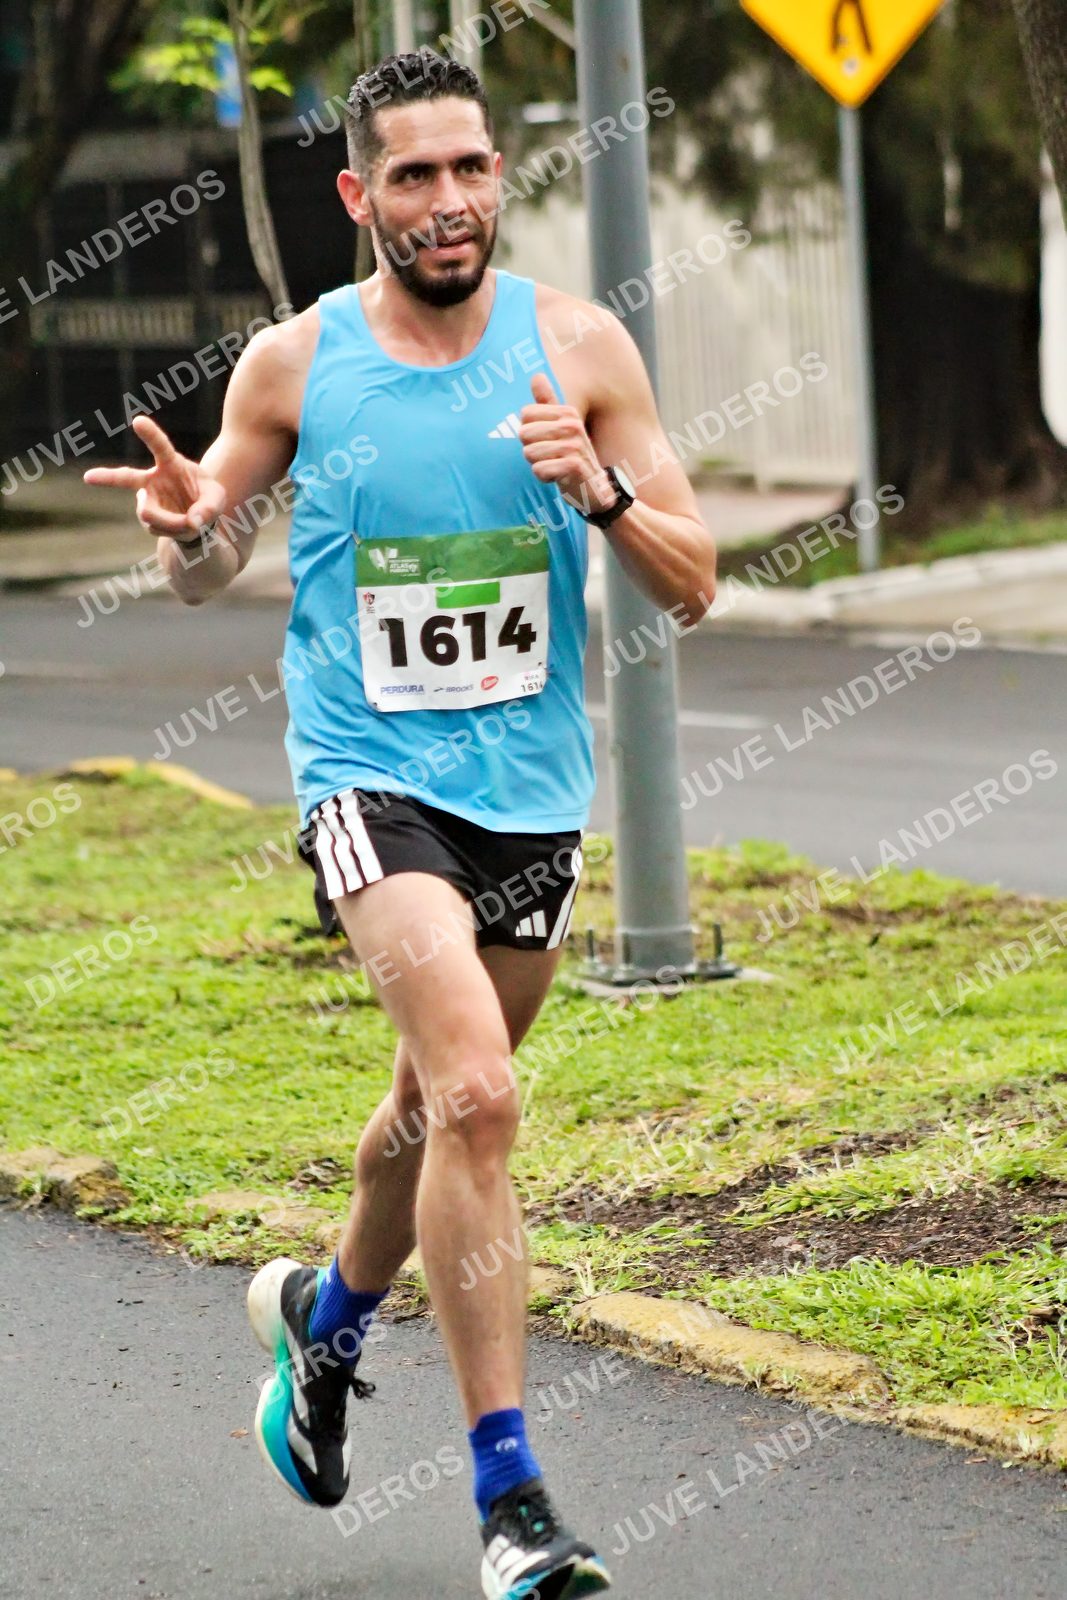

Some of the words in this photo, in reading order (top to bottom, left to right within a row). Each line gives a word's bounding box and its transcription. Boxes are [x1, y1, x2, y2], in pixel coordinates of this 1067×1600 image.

[379, 606, 537, 668] 1614
[380, 684, 424, 695] PERDURA
[446, 684, 474, 693] BROOKS
